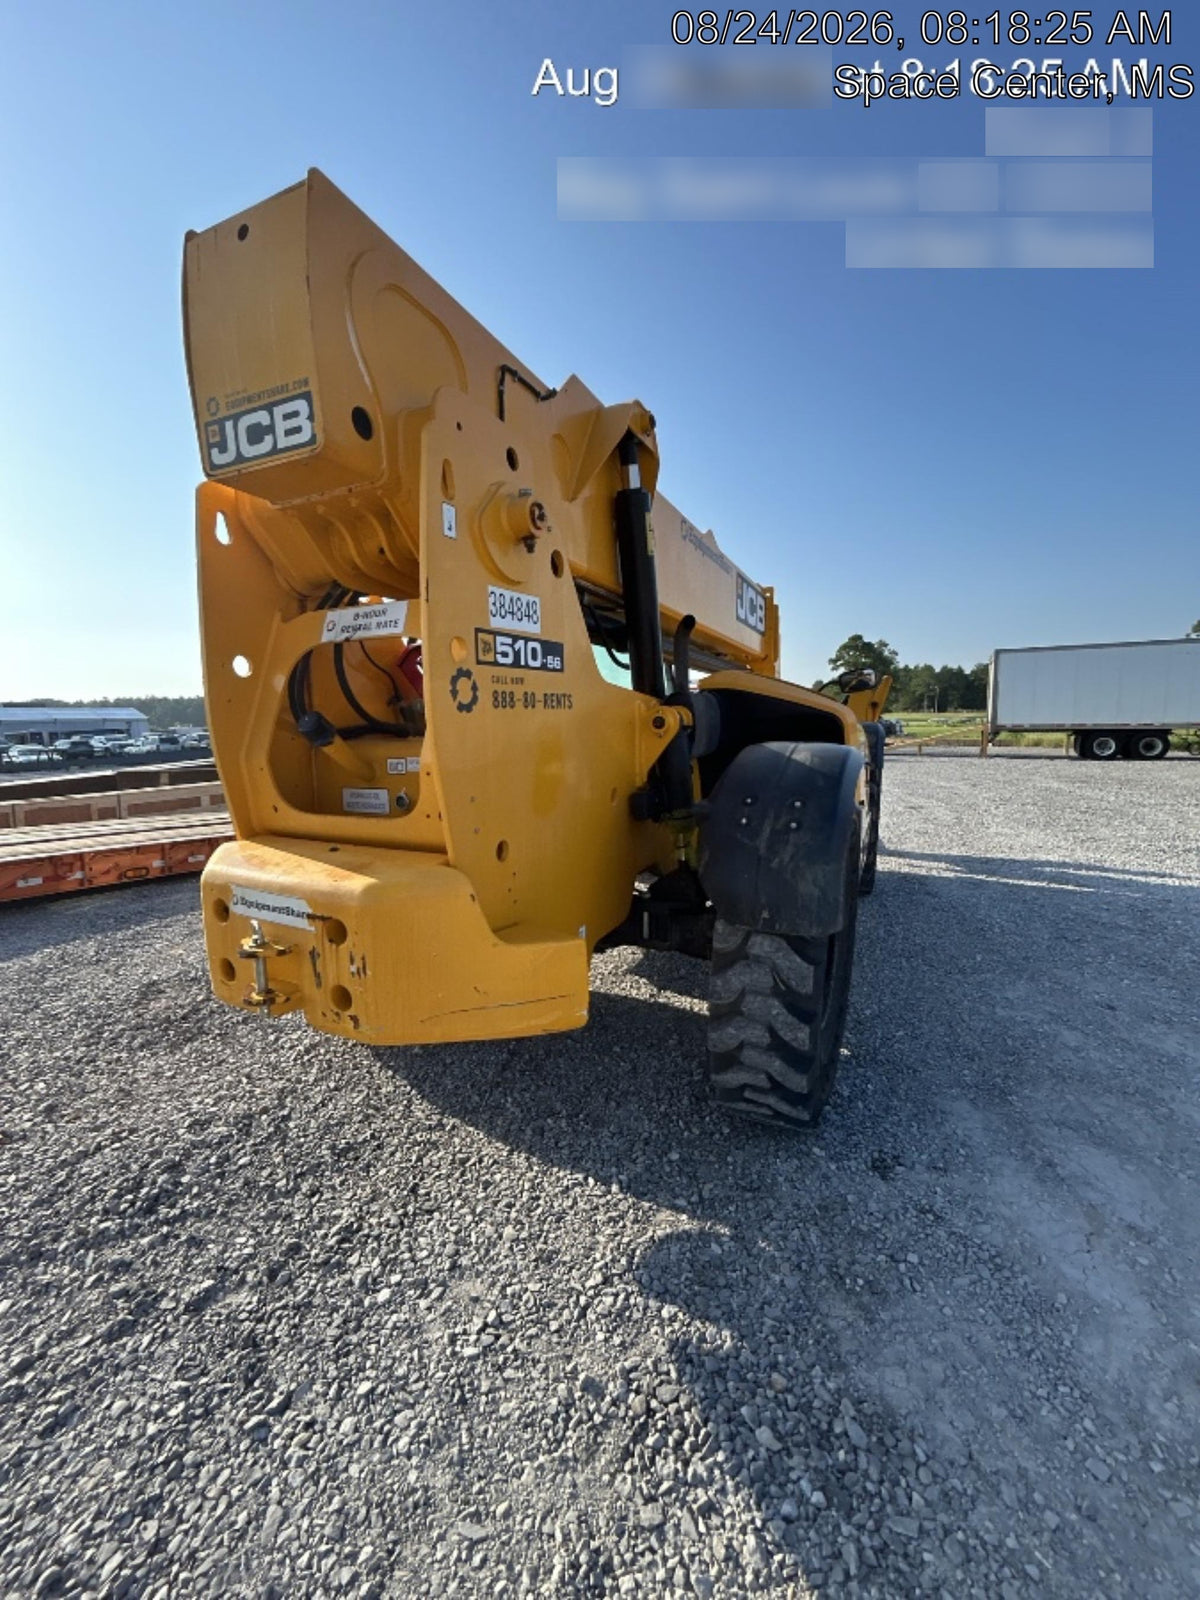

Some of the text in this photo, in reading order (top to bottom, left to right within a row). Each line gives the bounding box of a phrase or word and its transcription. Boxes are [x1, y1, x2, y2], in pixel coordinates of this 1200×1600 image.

[210, 399, 313, 465] JCB
[489, 591, 540, 625] 384848
[737, 580, 766, 632] JCB
[492, 690, 573, 710] 888-80-RENTS
